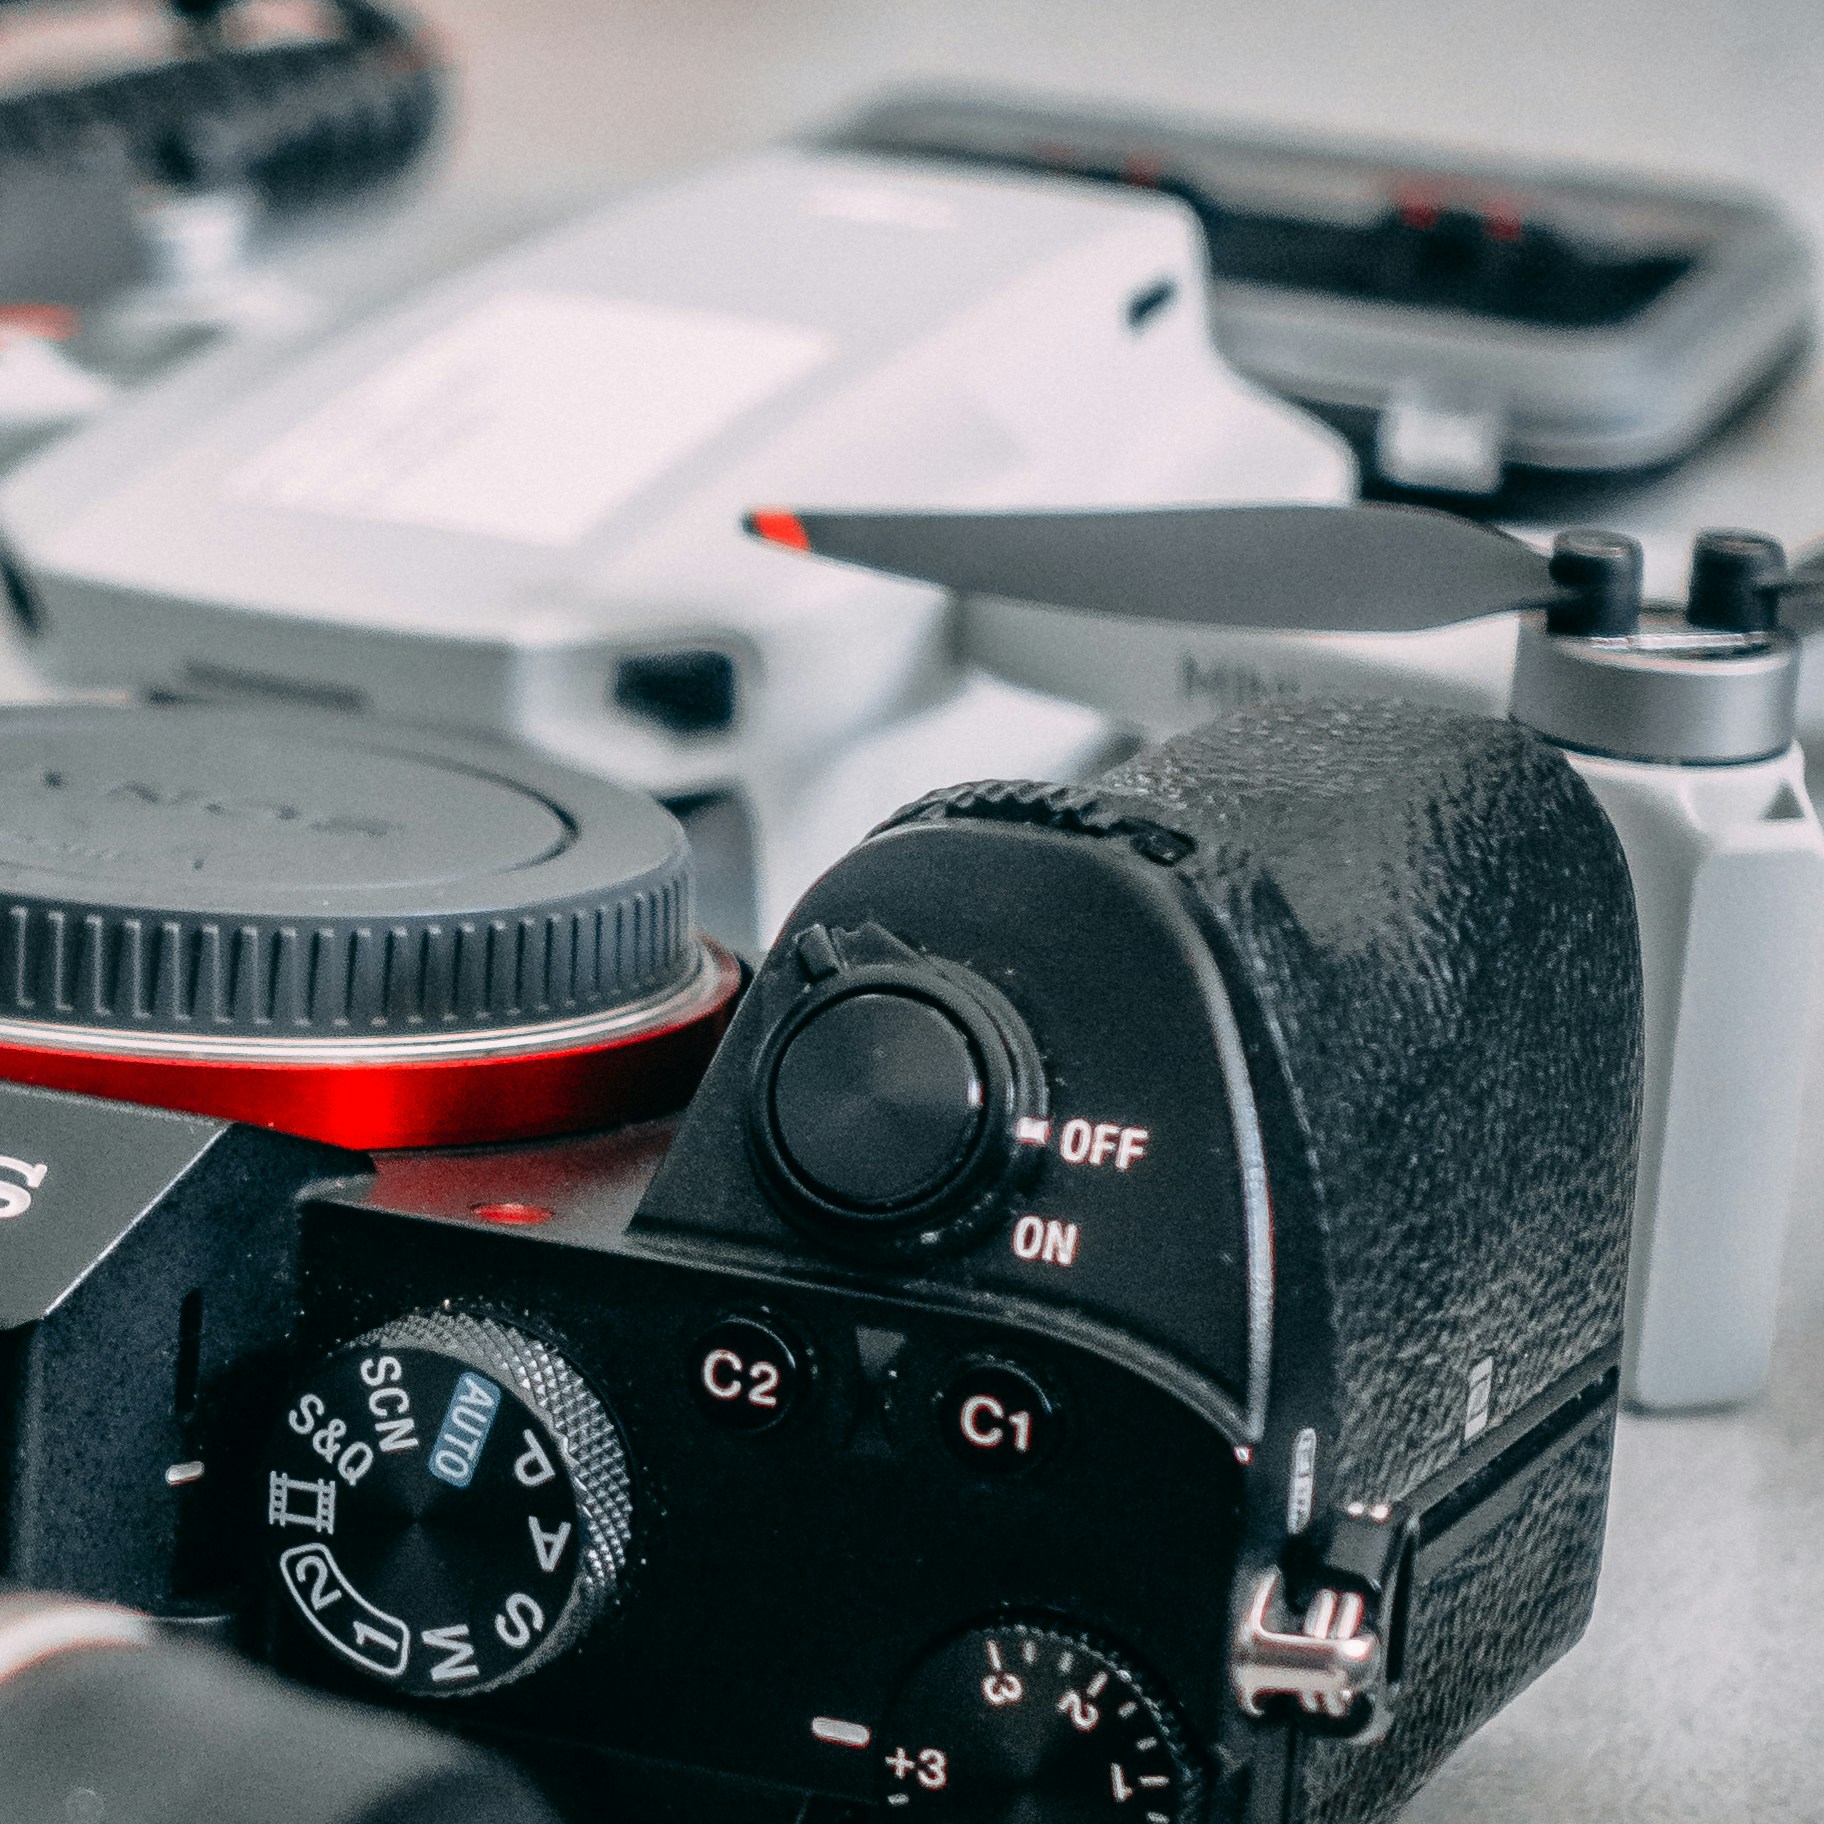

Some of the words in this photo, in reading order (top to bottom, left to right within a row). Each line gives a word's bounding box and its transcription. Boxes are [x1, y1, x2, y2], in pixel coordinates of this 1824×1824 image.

[1059, 1117, 1150, 1171] OFF
[1012, 1214, 1080, 1268] ON
[360, 1355, 420, 1454] SCN
[701, 1347, 782, 1409] C2
[288, 1393, 375, 1487] S&Q
[433, 1376, 497, 1483] AUTO
[959, 1392, 1033, 1453] C1
[513, 1429, 558, 1488] P
[528, 1515, 572, 1573] A
[294, 1555, 344, 1612] 2
[352, 1618, 401, 1655] 1
[495, 1591, 546, 1649] S
[421, 1623, 481, 1683] M
[884, 1746, 950, 1791] +3
